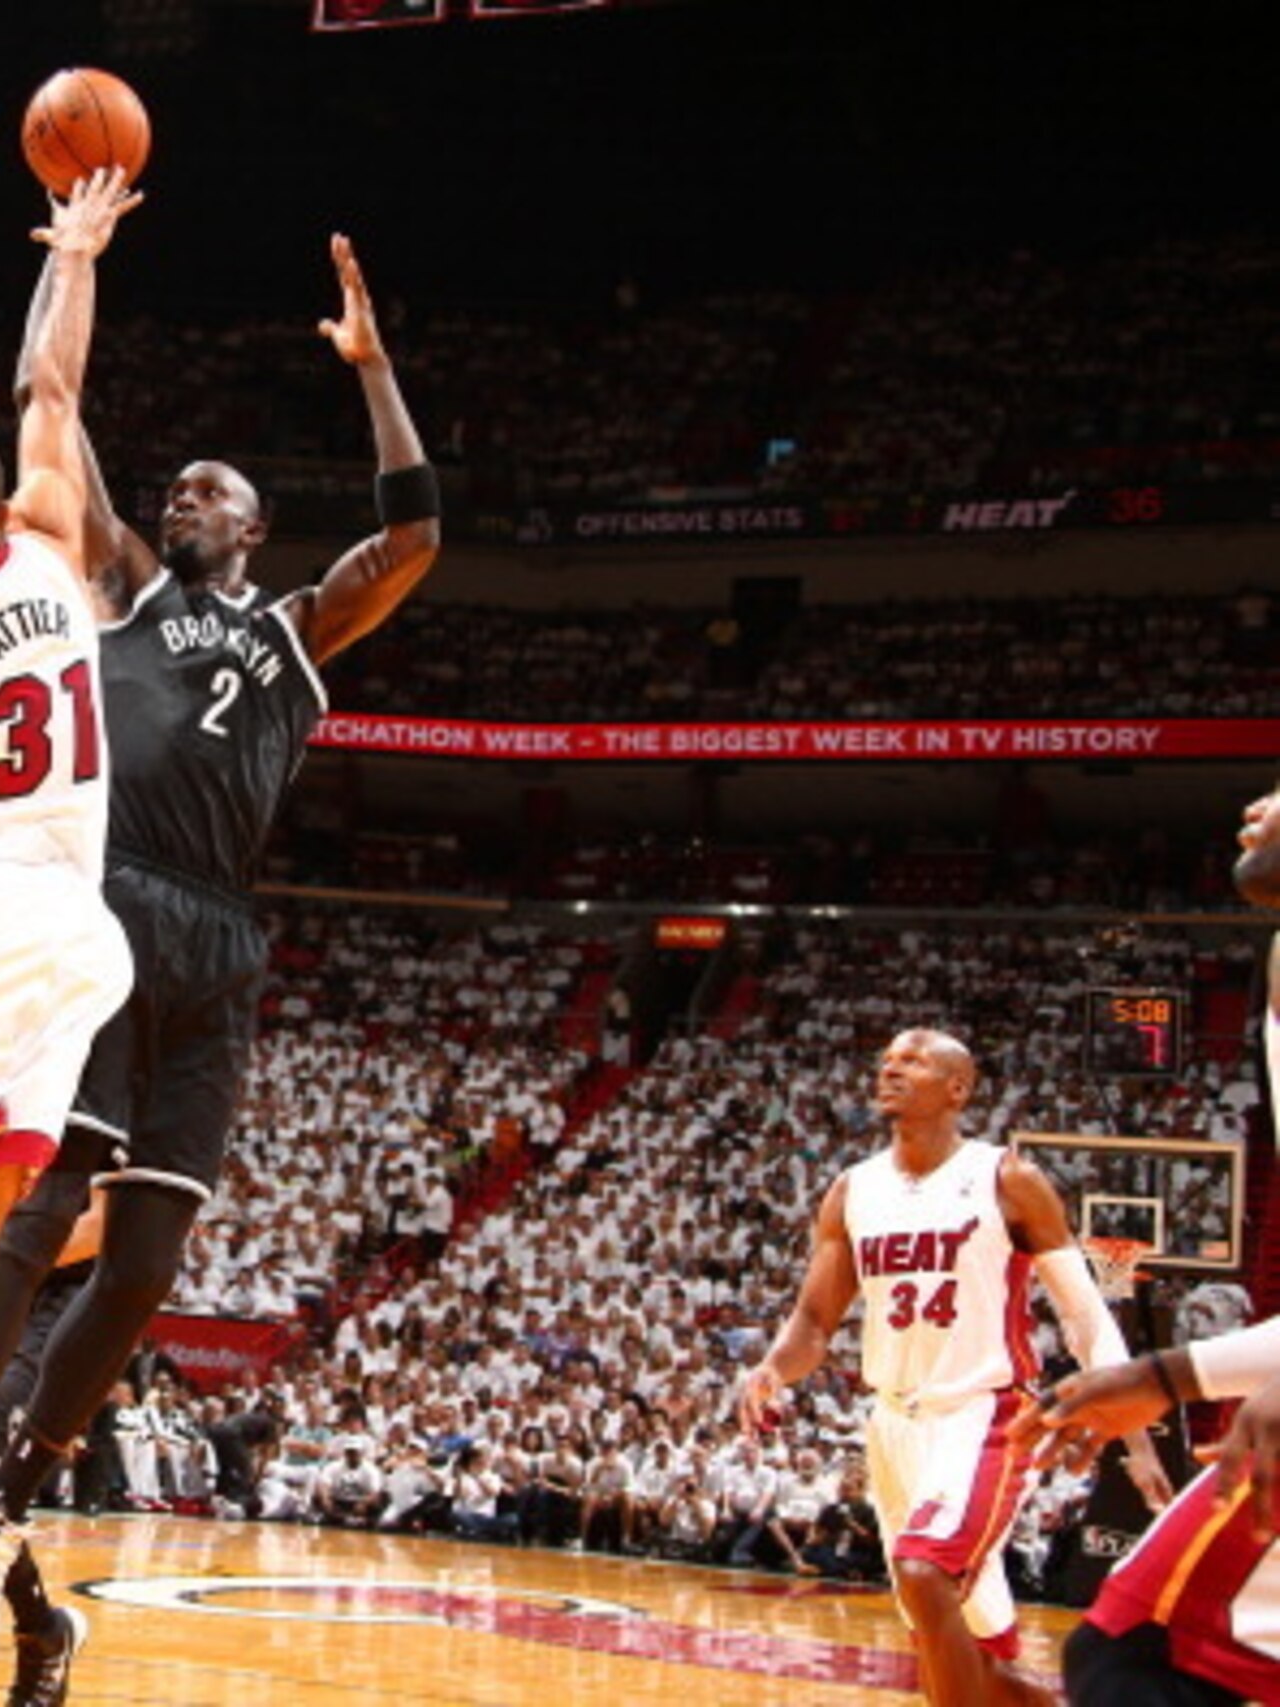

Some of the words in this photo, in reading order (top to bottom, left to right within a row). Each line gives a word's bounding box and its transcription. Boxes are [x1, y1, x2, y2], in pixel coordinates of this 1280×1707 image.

[577, 510, 712, 536] OFFENSIVE
[721, 507, 803, 531] STATS
[942, 489, 1077, 531] HEAT
[159, 611, 284, 687] BROKYN
[198, 667, 244, 738] 2
[483, 729, 570, 752] WEEK
[604, 730, 658, 752] THE
[669, 729, 801, 752] BIGGEST
[811, 729, 905, 751] WEEK
[917, 729, 949, 751] IN
[961, 729, 1002, 751] TV
[1013, 727, 1162, 751] HISTORY
[1113, 998, 1169, 1022] 5:08
[860, 1215, 980, 1279] HEAT
[887, 1279, 959, 1332] 34
